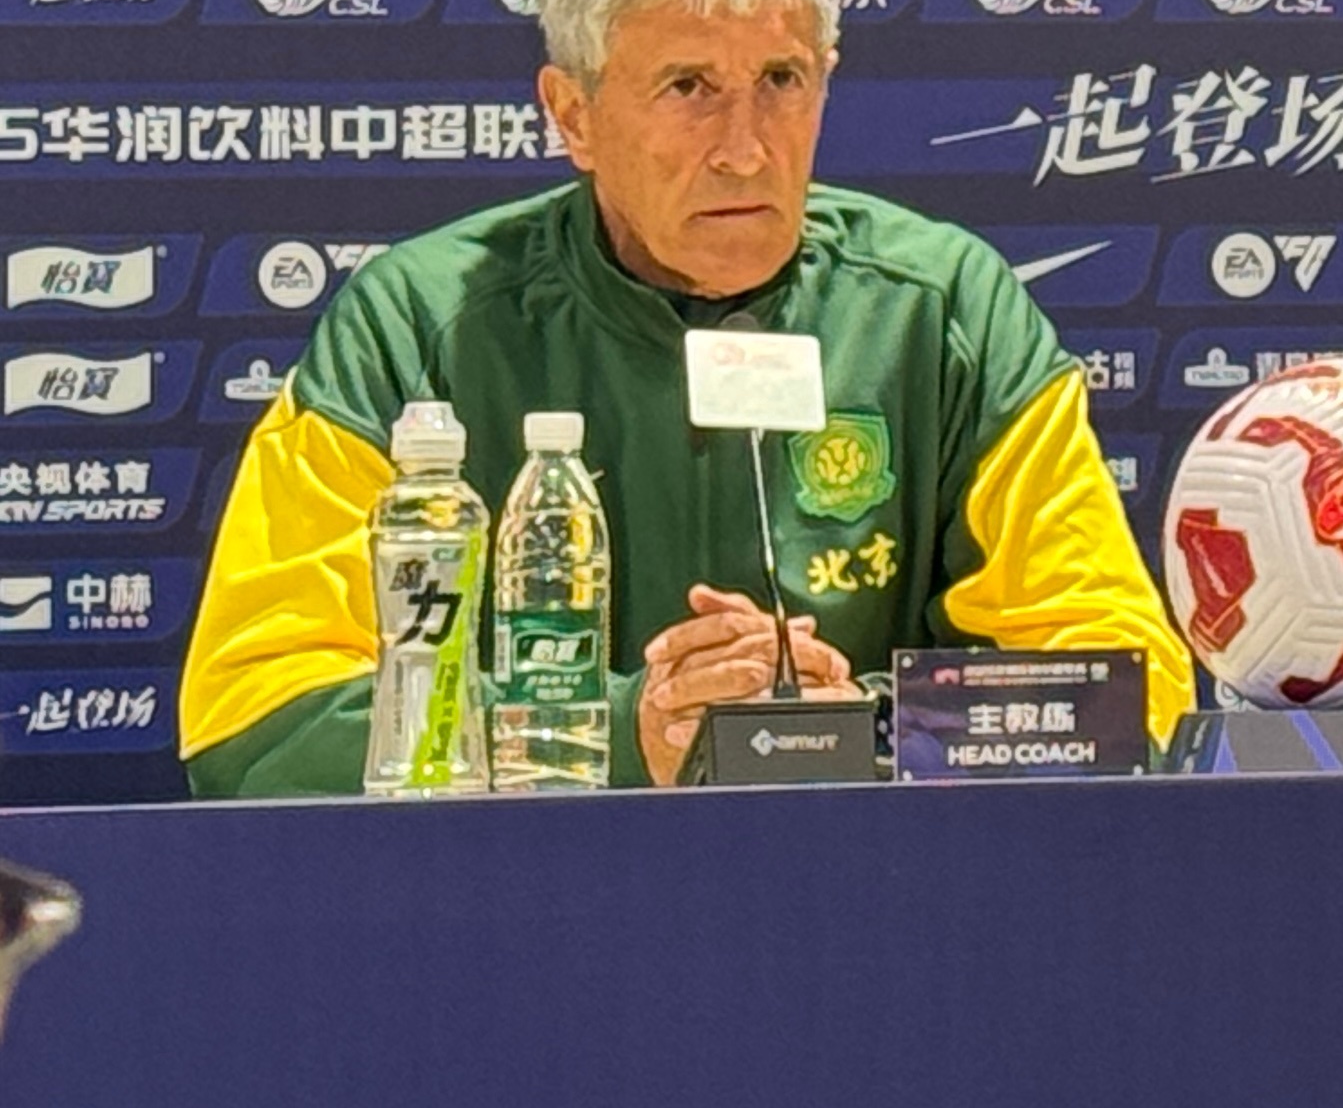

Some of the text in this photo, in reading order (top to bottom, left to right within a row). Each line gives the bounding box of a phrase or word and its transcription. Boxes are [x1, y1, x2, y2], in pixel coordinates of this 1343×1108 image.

[272, 254, 312, 279] EA
[43, 498, 165, 524] SPORTS
[808, 533, 898, 595] 北京
[968, 703, 1075, 734] 主教练
[947, 741, 1097, 768] HEAD COACH
